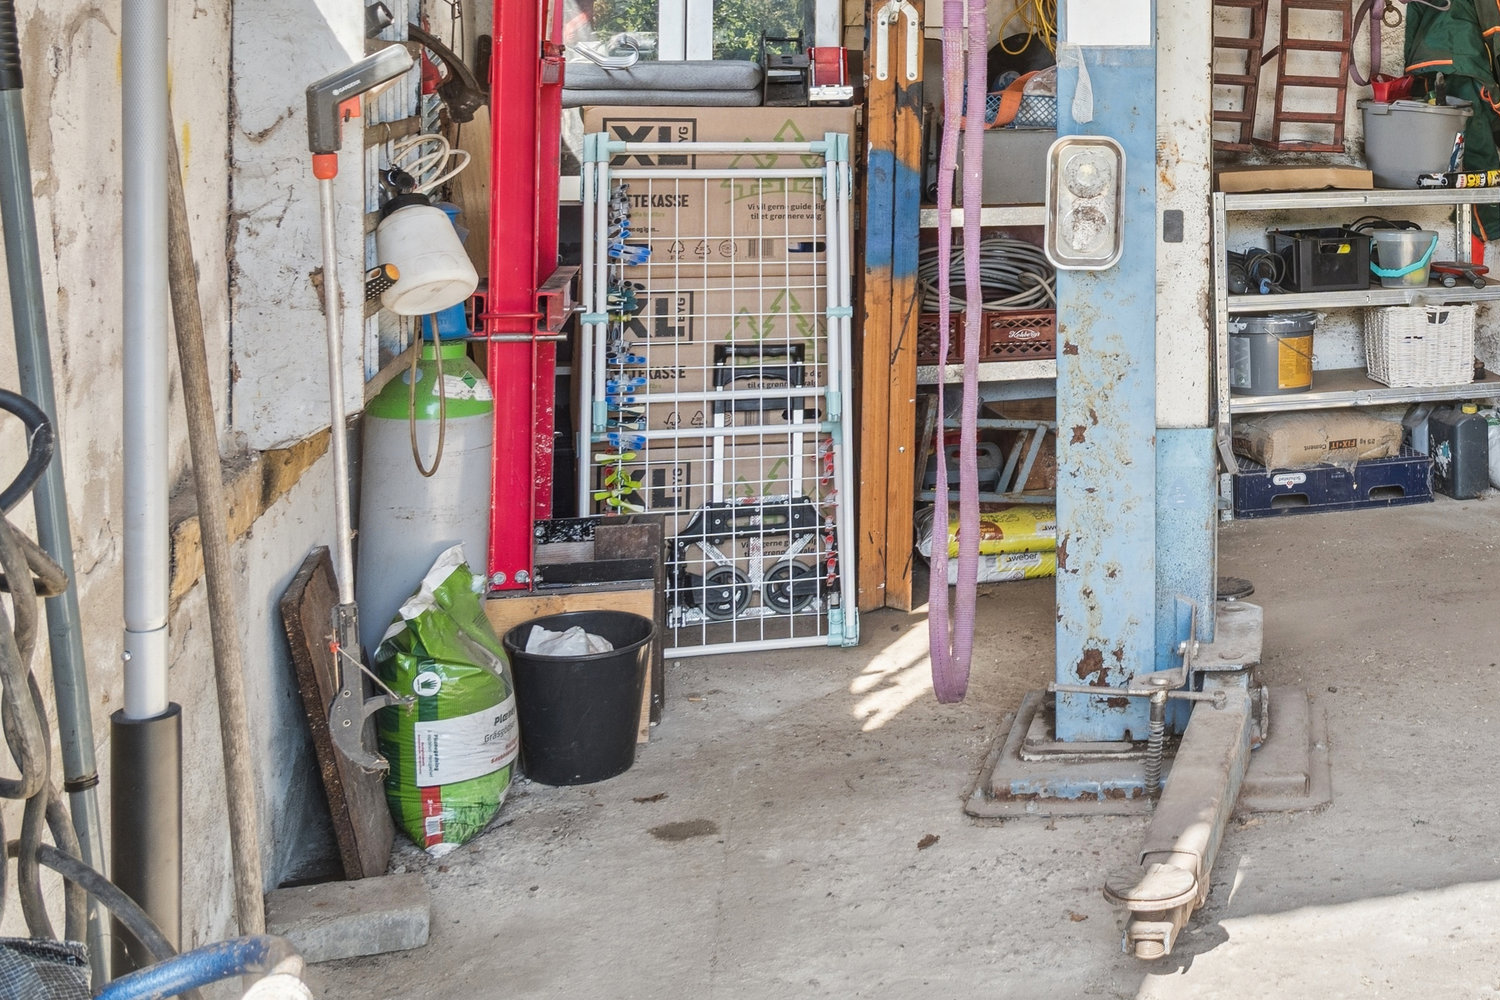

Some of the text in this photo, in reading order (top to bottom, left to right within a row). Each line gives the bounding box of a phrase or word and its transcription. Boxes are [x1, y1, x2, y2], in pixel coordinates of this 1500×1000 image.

[609, 125, 688, 166] XL
[790, 202, 811, 211] guide
[1011, 552, 1038, 561] weber
